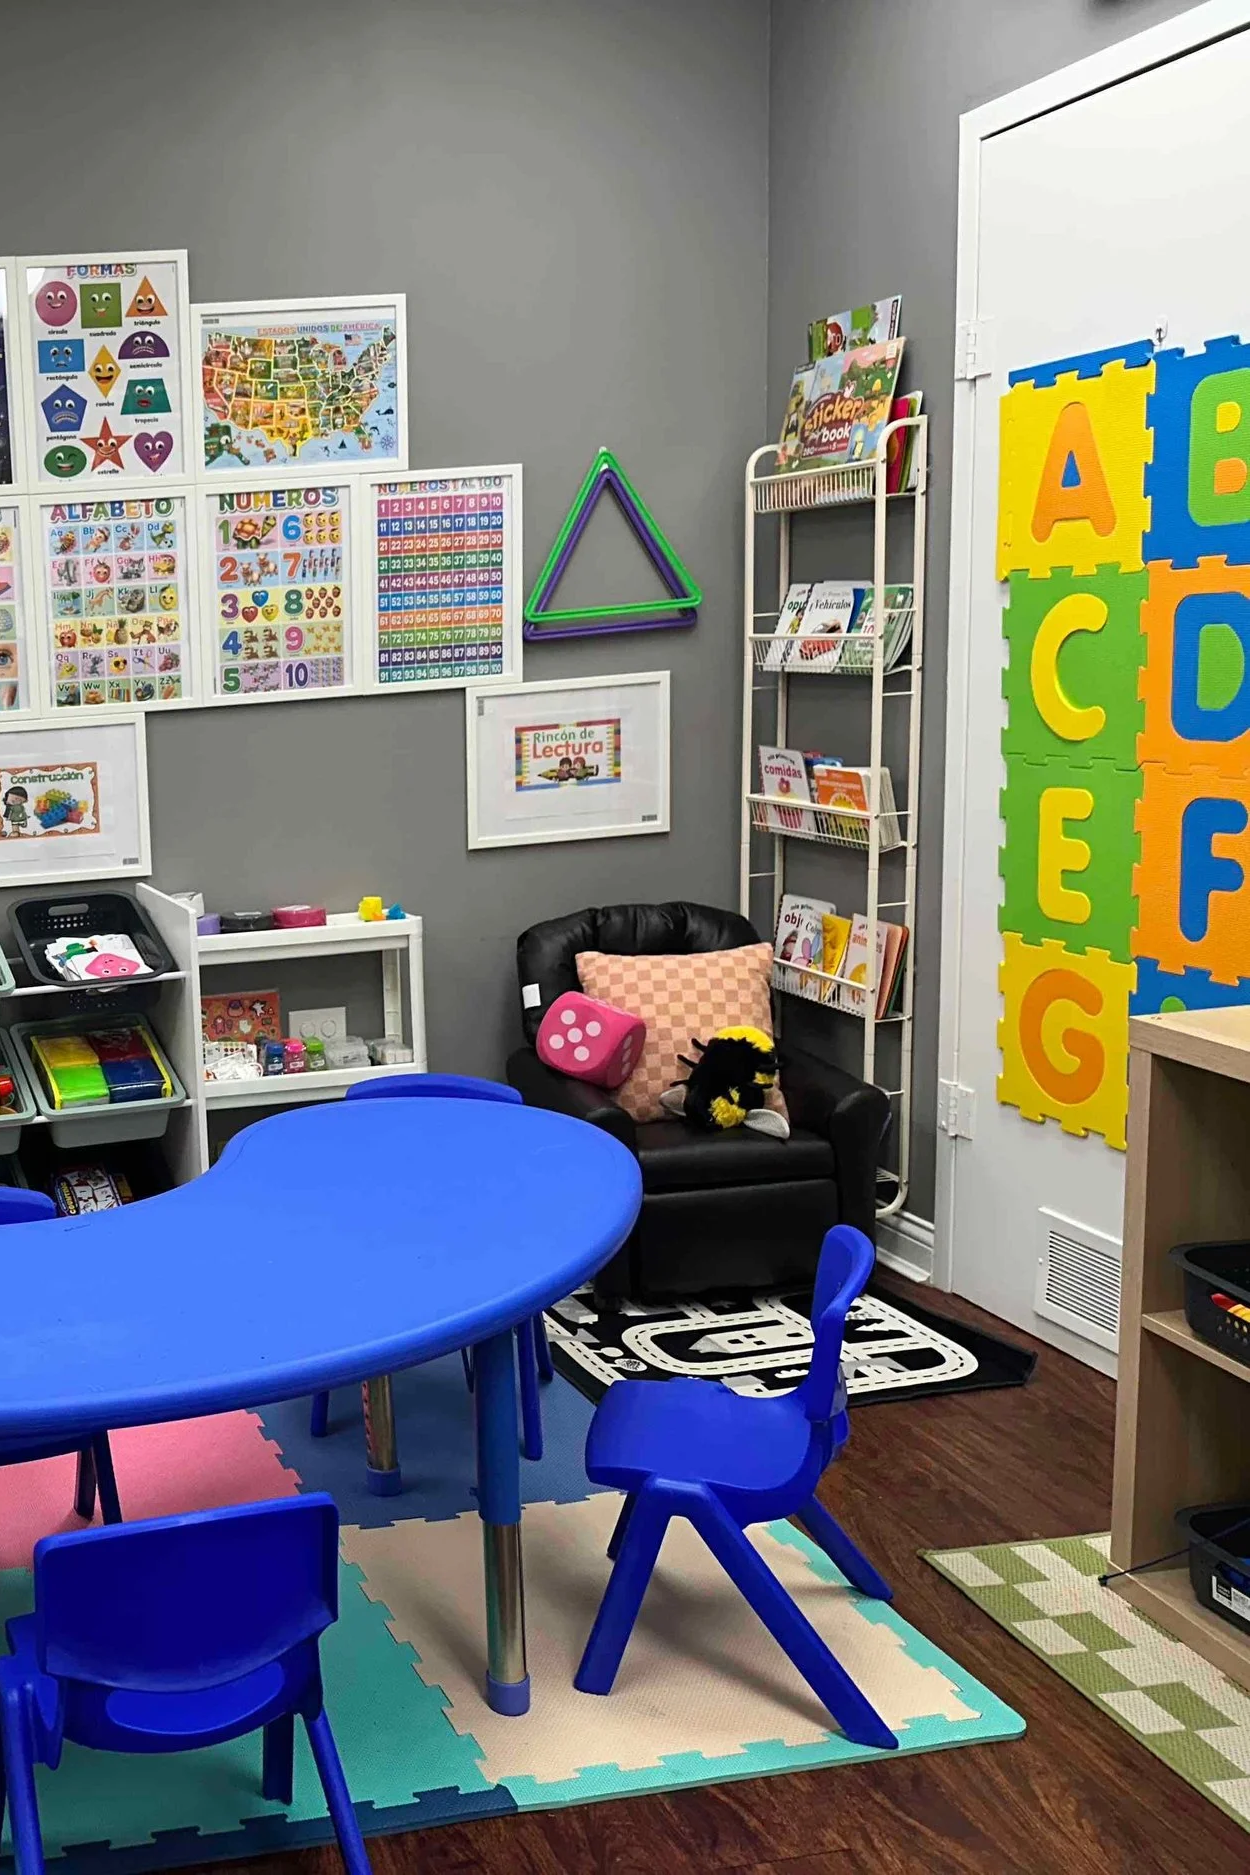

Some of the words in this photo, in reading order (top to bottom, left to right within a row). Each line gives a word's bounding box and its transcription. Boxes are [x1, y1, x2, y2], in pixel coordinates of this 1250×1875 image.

[67, 264, 137, 278] FORMAS
[258, 326, 296, 336] ESTADOS
[297, 325, 329, 333] UNIDOS
[804, 395, 862, 430] sticker
[822, 422, 851, 443] book
[1188, 369, 1250, 527] B
[461, 479, 475, 488] AL
[478, 476, 503, 489] 100
[1032, 402, 1116, 543] A
[50, 499, 174, 523] ALFABETO
[381, 504, 385, 512] 1
[393, 503, 399, 512] 2
[406, 503, 411, 511] 3
[418, 501, 424, 510] 4
[431, 501, 436, 510] 5
[443, 500, 449, 509] 6
[456, 499, 462, 508] 7
[469, 498, 475, 507] 8
[481, 498, 487, 506] 9
[492, 497, 501, 506] 10
[83, 527, 94, 535] Bb
[218, 519, 230, 544] 1
[282, 515, 303, 541] 6
[220, 556, 238, 582] 2
[283, 552, 302, 578] 7
[221, 593, 239, 619] 3
[284, 590, 303, 615] 8
[222, 630, 242, 655] 4
[285, 626, 303, 652] 9
[56, 654, 69, 662] Qq
[1032, 593, 1108, 741] C
[1172, 592, 1250, 742] D
[222, 667, 241, 692] 5
[285, 662, 309, 688] 10
[533, 730, 576, 742] Rincón
[580, 728, 594, 738] de
[533, 741, 603, 759] Lectura
[765, 764, 802, 778] comidas
[1038, 788, 1094, 924] E
[1180, 798, 1248, 942] F
[1020, 969, 1105, 1104] G
